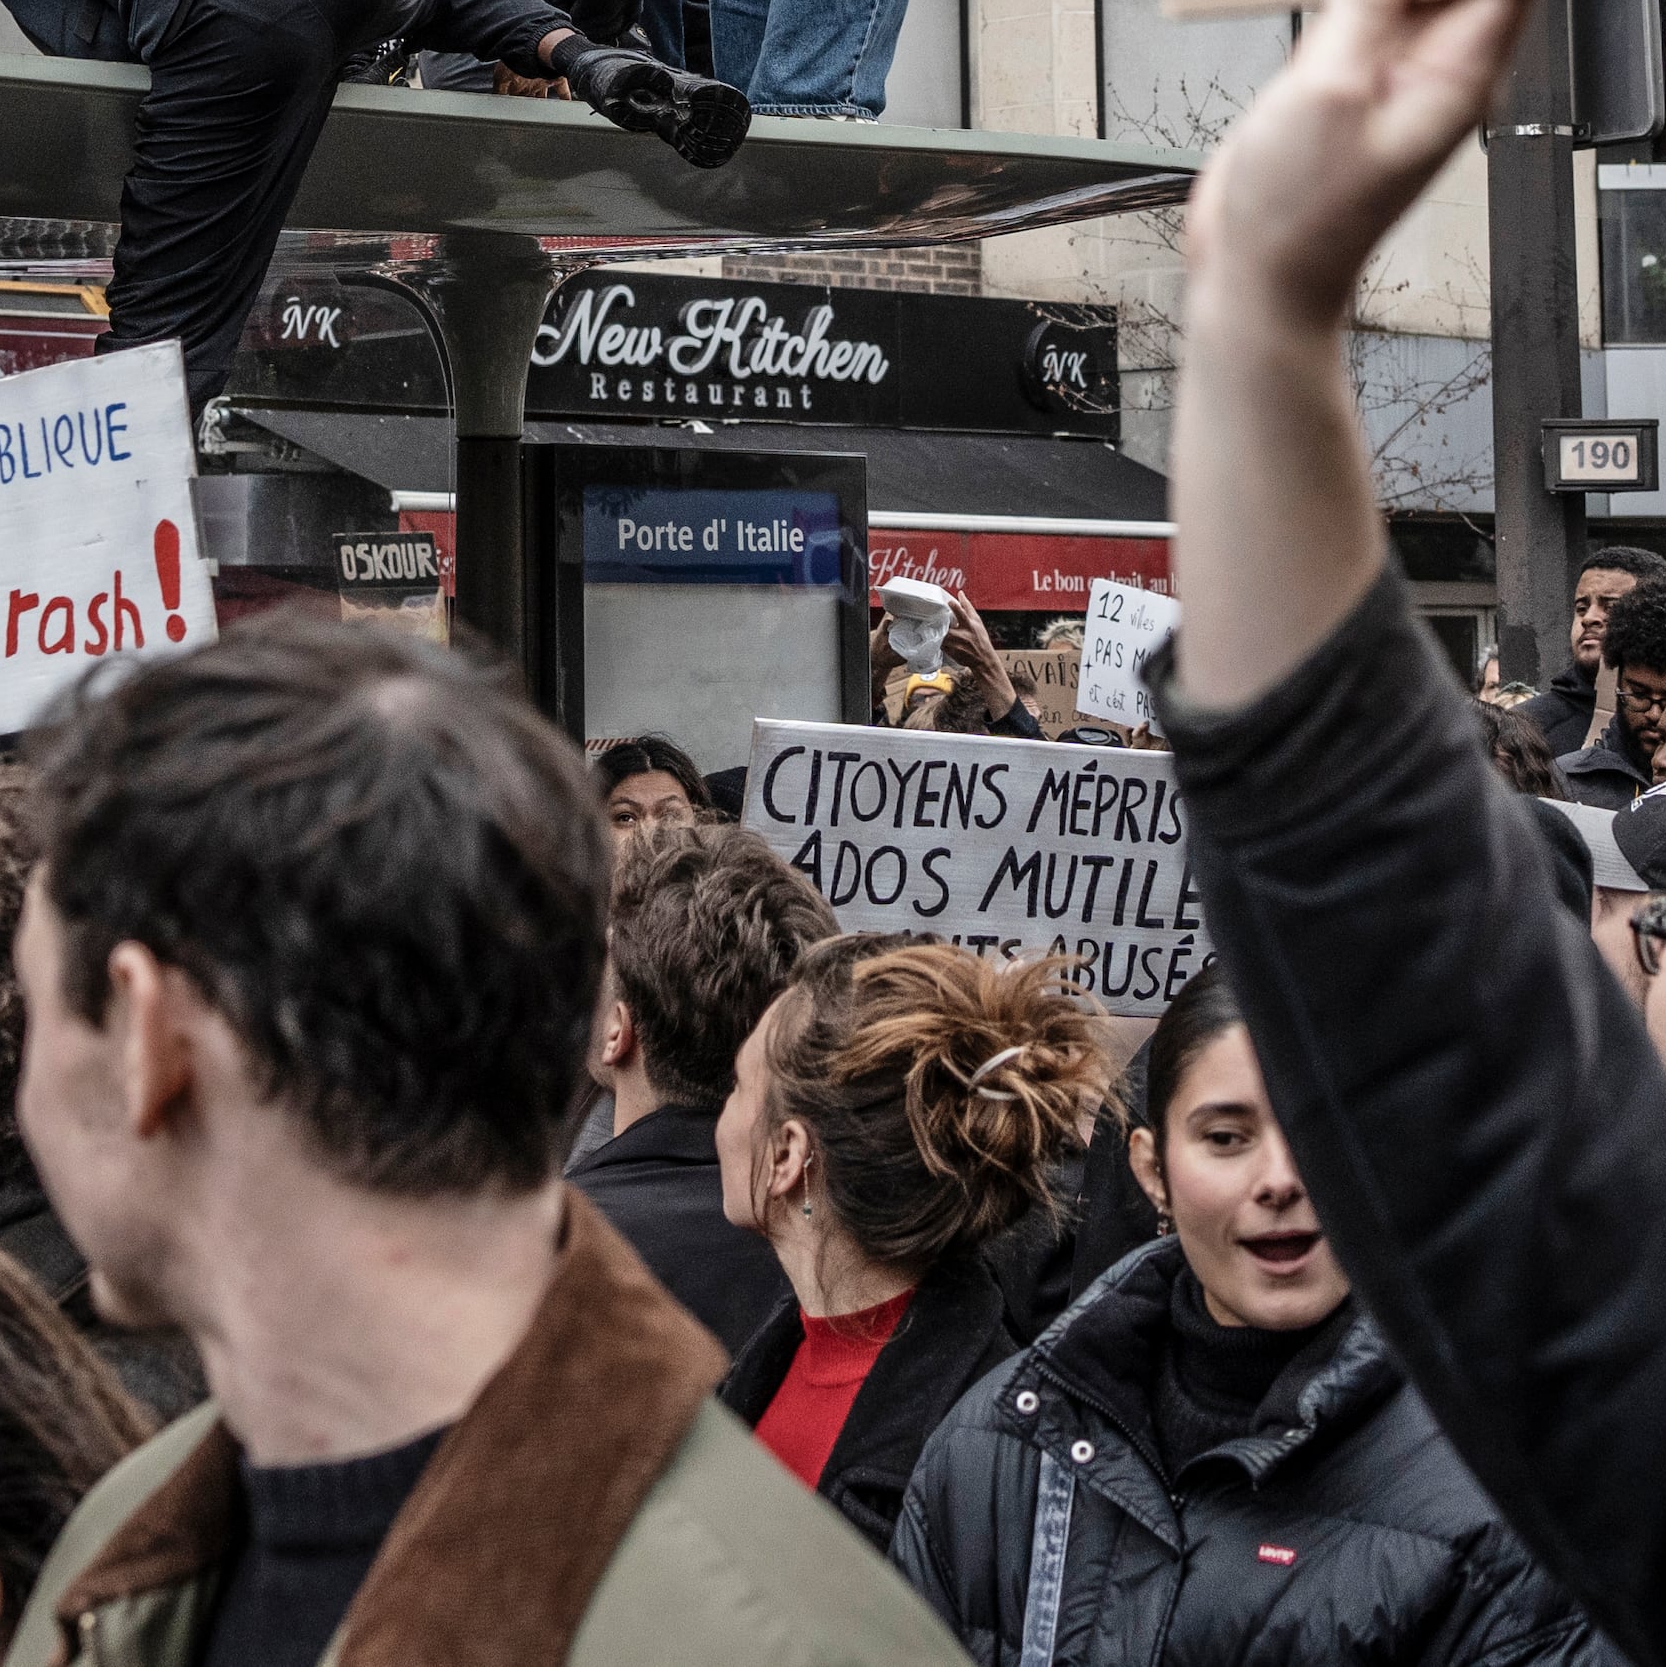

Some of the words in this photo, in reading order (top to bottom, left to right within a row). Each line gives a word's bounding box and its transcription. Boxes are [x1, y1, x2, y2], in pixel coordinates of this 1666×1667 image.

[531, 284, 663, 367] New
[669, 294, 889, 386] Kitchen
[590, 373, 812, 409] Restaurant
[1571, 440, 1630, 470] 190
[617, 517, 695, 553] Porte
[703, 517, 727, 553] d'
[738, 517, 805, 553] Italie
[340, 542, 439, 580] OSKOUR
[1033, 570, 1052, 592] Le
[1054, 569, 1084, 592] bon
[1096, 590, 1124, 623] 12
[1095, 637, 1124, 668] PAS
[1089, 684, 1101, 704] et
[762, 746, 1009, 830] CITOYENS
[790, 830, 952, 917] ADOS
